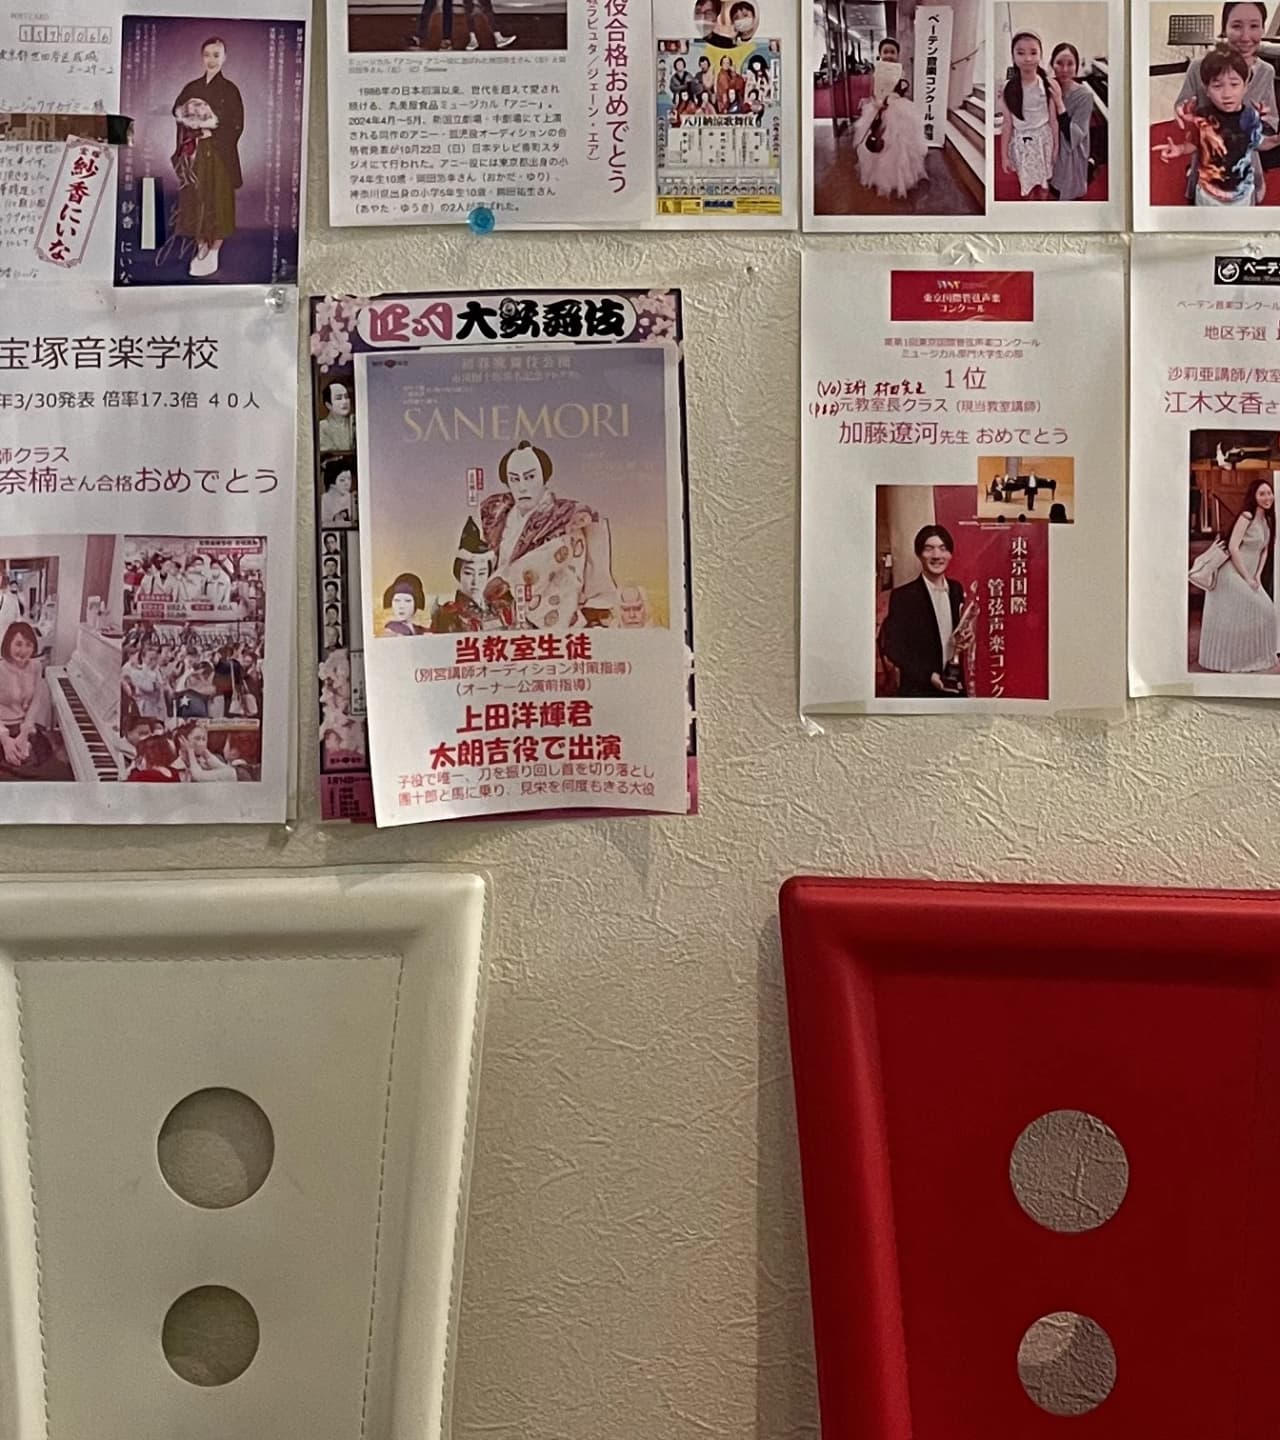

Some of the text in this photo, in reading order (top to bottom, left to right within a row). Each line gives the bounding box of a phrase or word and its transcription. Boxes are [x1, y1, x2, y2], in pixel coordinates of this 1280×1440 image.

[49, 156, 99, 262] 紗香にいな
[939, 304, 985, 313] コンクール
[1204, 326, 1266, 342] 地区予選
[945, 366, 987, 389] 1位
[102, 390, 199, 410] 倍率17.3倍
[840, 397, 948, 413] 元教室長クラス
[403, 402, 631, 443] SANEMORI
[838, 420, 1069, 445] 加藤遼河先生 おめでとう
[1009, 535, 1029, 614] 東京国際
[455, 633, 593, 665] 当教室生徒
[456, 700, 594, 734] 上田洋輝君
